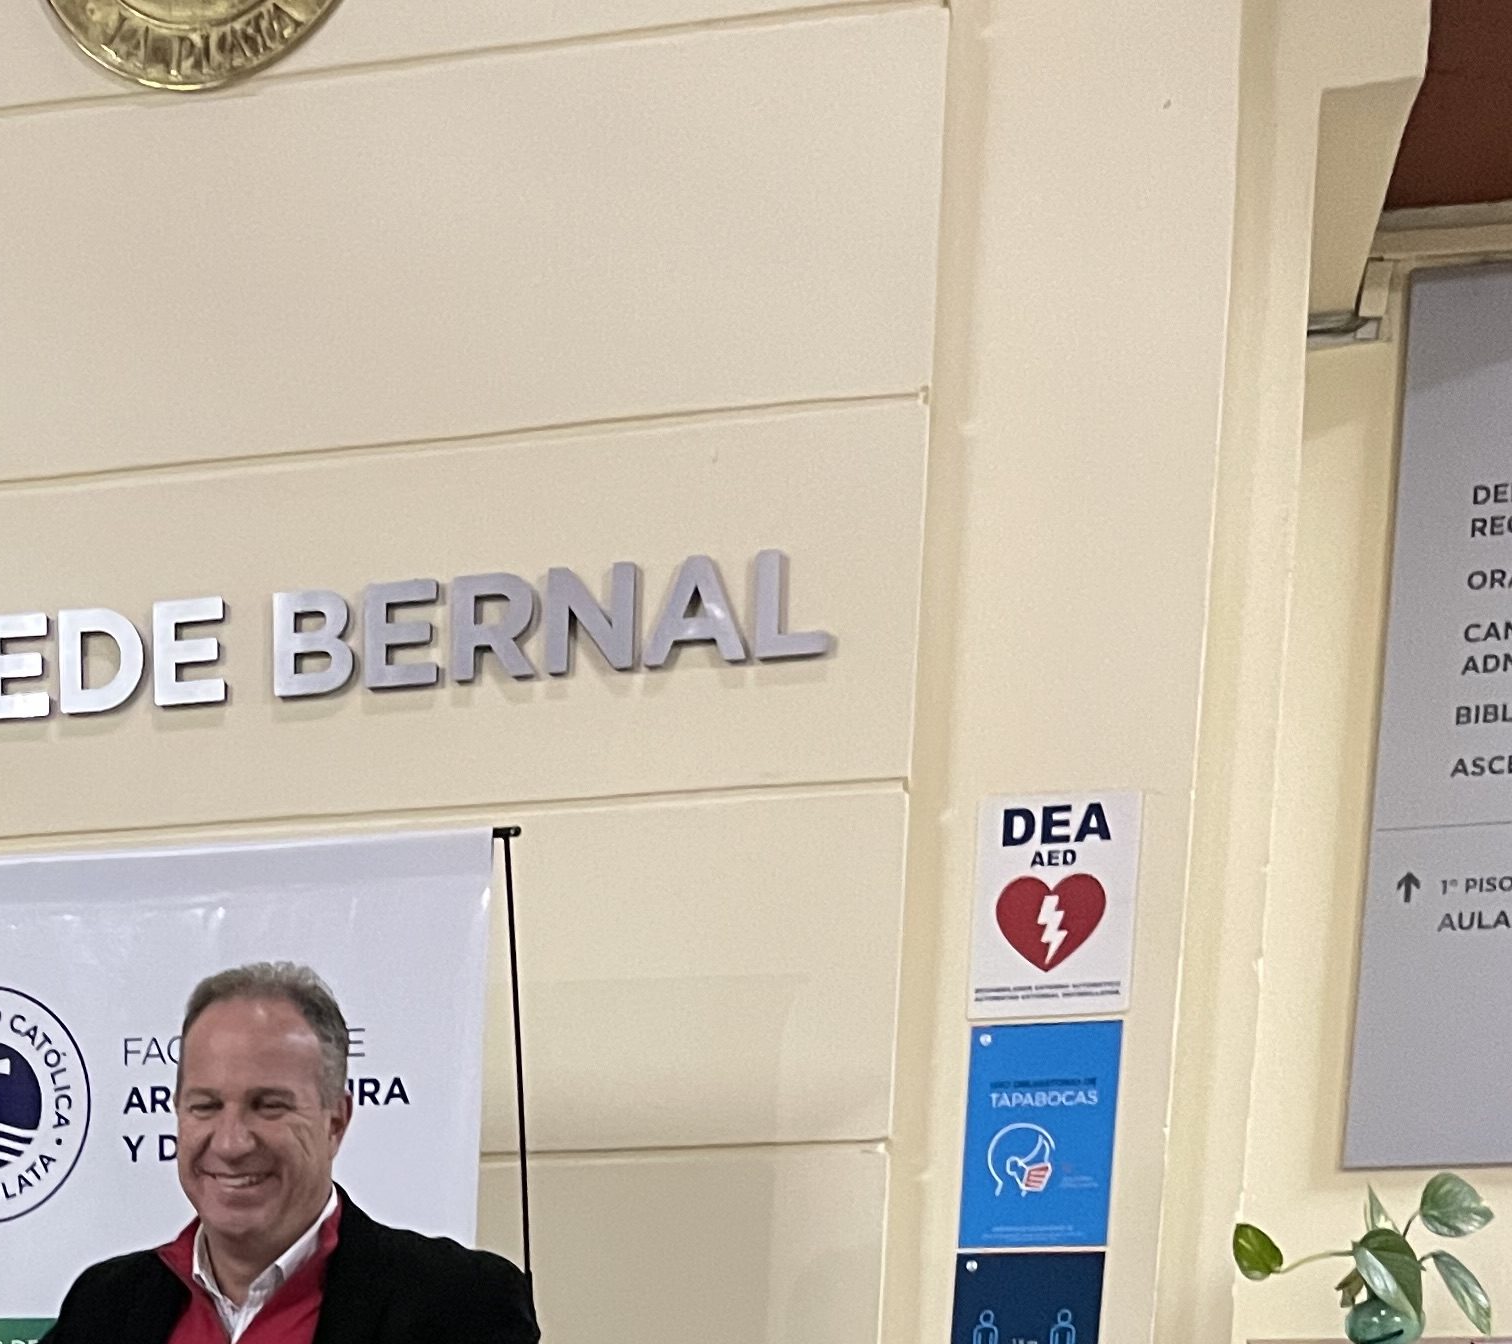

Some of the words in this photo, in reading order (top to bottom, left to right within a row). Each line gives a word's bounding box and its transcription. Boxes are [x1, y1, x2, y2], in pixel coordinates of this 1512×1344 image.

[1472, 483, 1512, 505] DE
[272, 549, 831, 700] BERNAL
[1002, 802, 1111, 847] DEA
[1030, 849, 1077, 868] AED
[1465, 875, 1512, 893] PISO
[10, 1013, 73, 1130] CATÓLICA
[990, 1090, 1098, 1109] TAPABOCAS
[122, 1134, 145, 1163] Y
